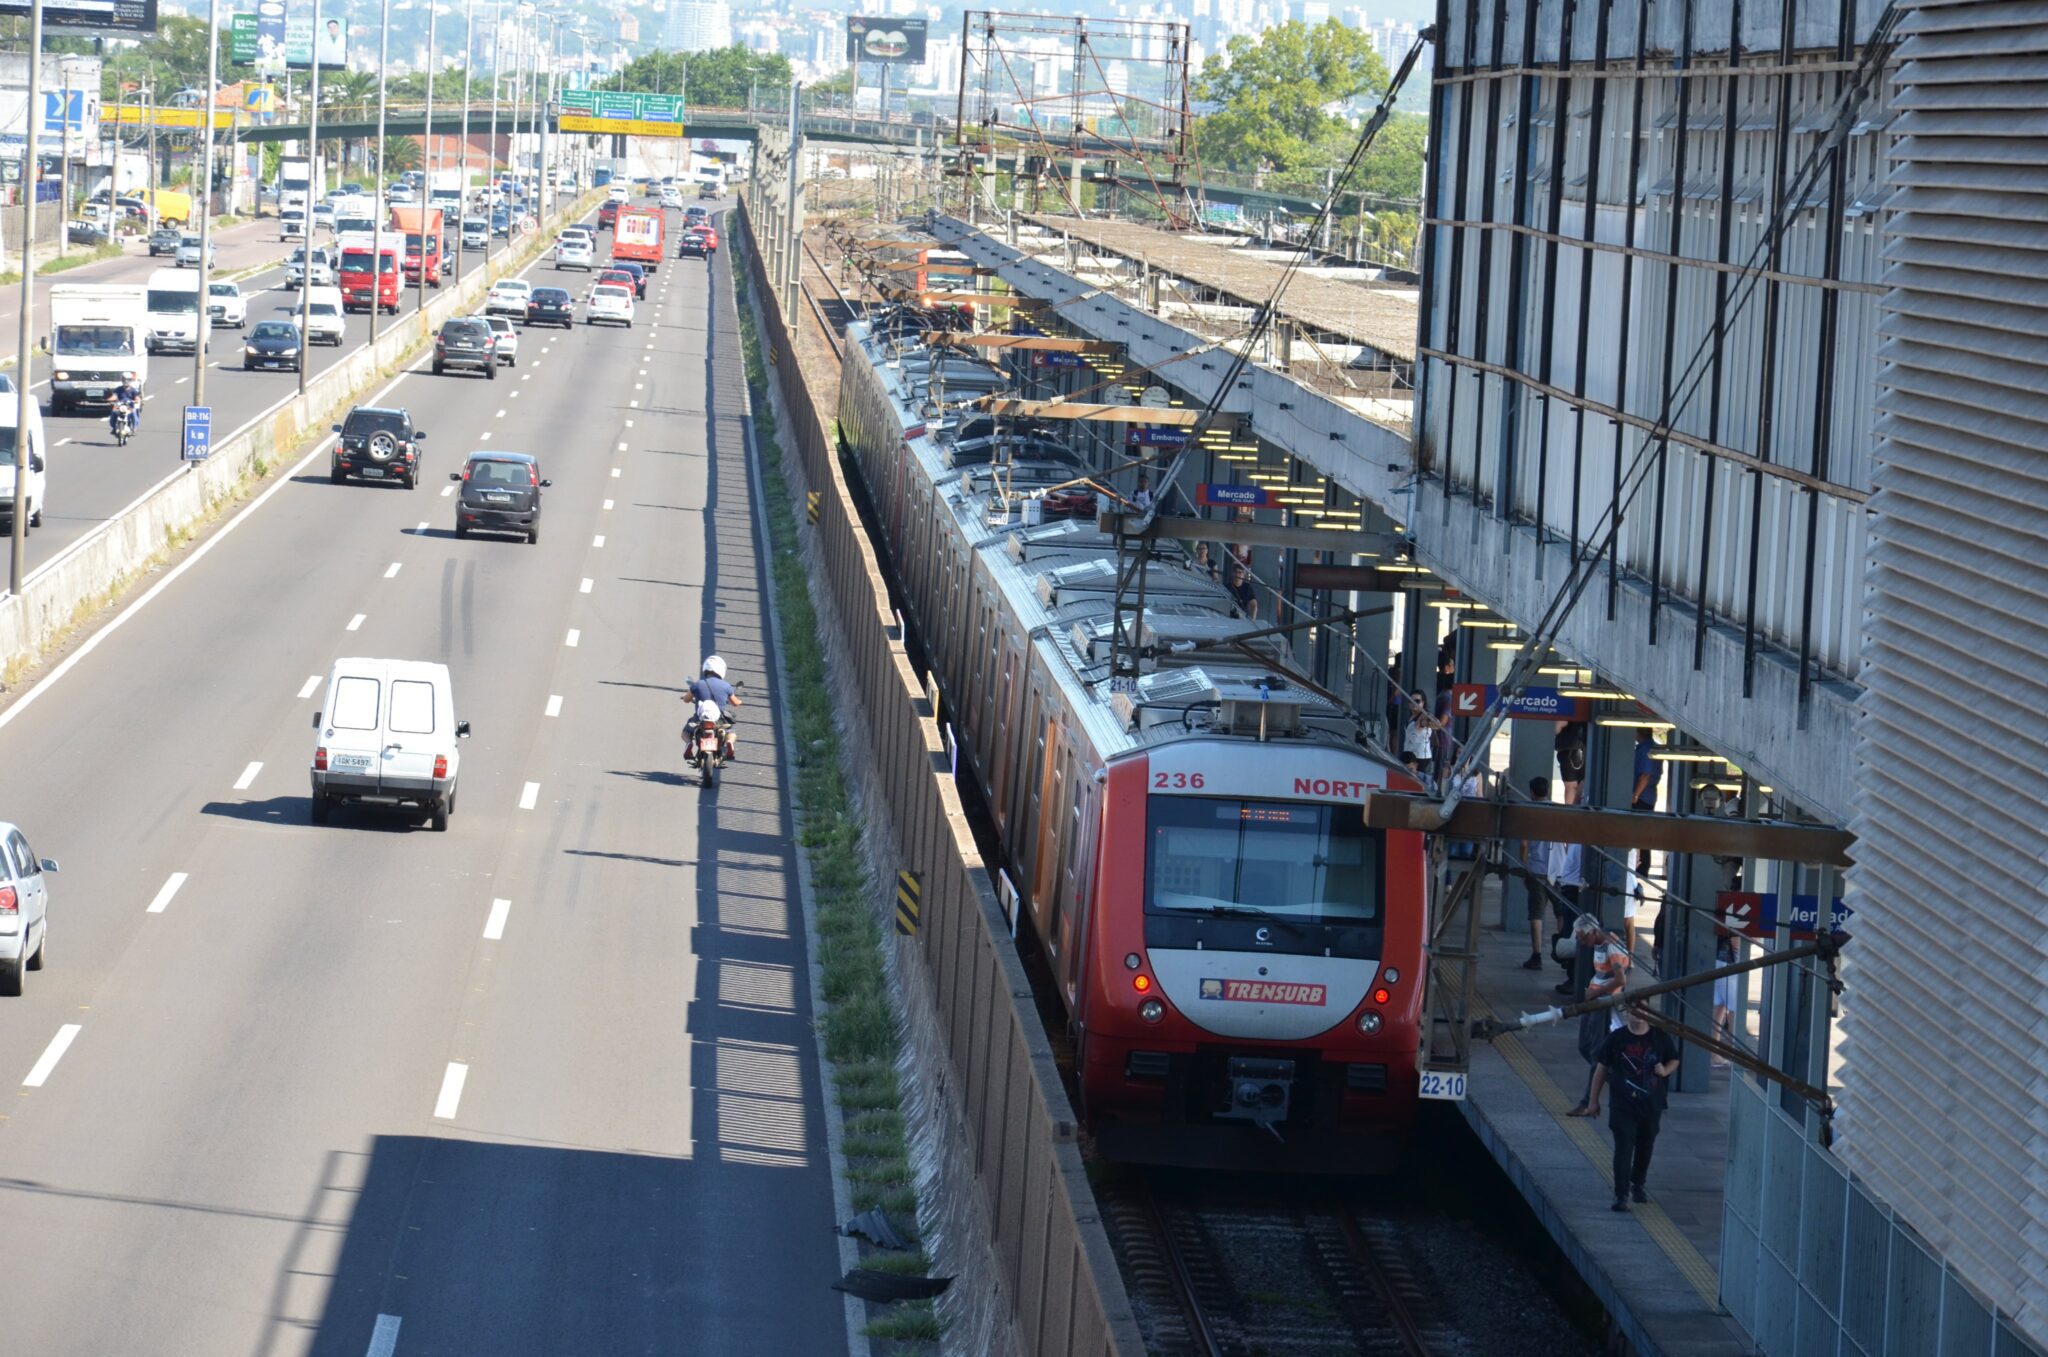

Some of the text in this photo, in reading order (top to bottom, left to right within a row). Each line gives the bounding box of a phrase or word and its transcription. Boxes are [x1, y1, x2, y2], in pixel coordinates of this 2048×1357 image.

[523, 220, 535, 230] 80
[187, 412, 209, 421] BR-116
[1151, 433, 1187, 443] Embarqu
[187, 444, 208, 456] 269
[1218, 490, 1255, 499] Mercado
[1502, 696, 1557, 707] Mercado
[1154, 772, 1205, 789] 236
[1228, 982, 1323, 1003] TRENSURB
